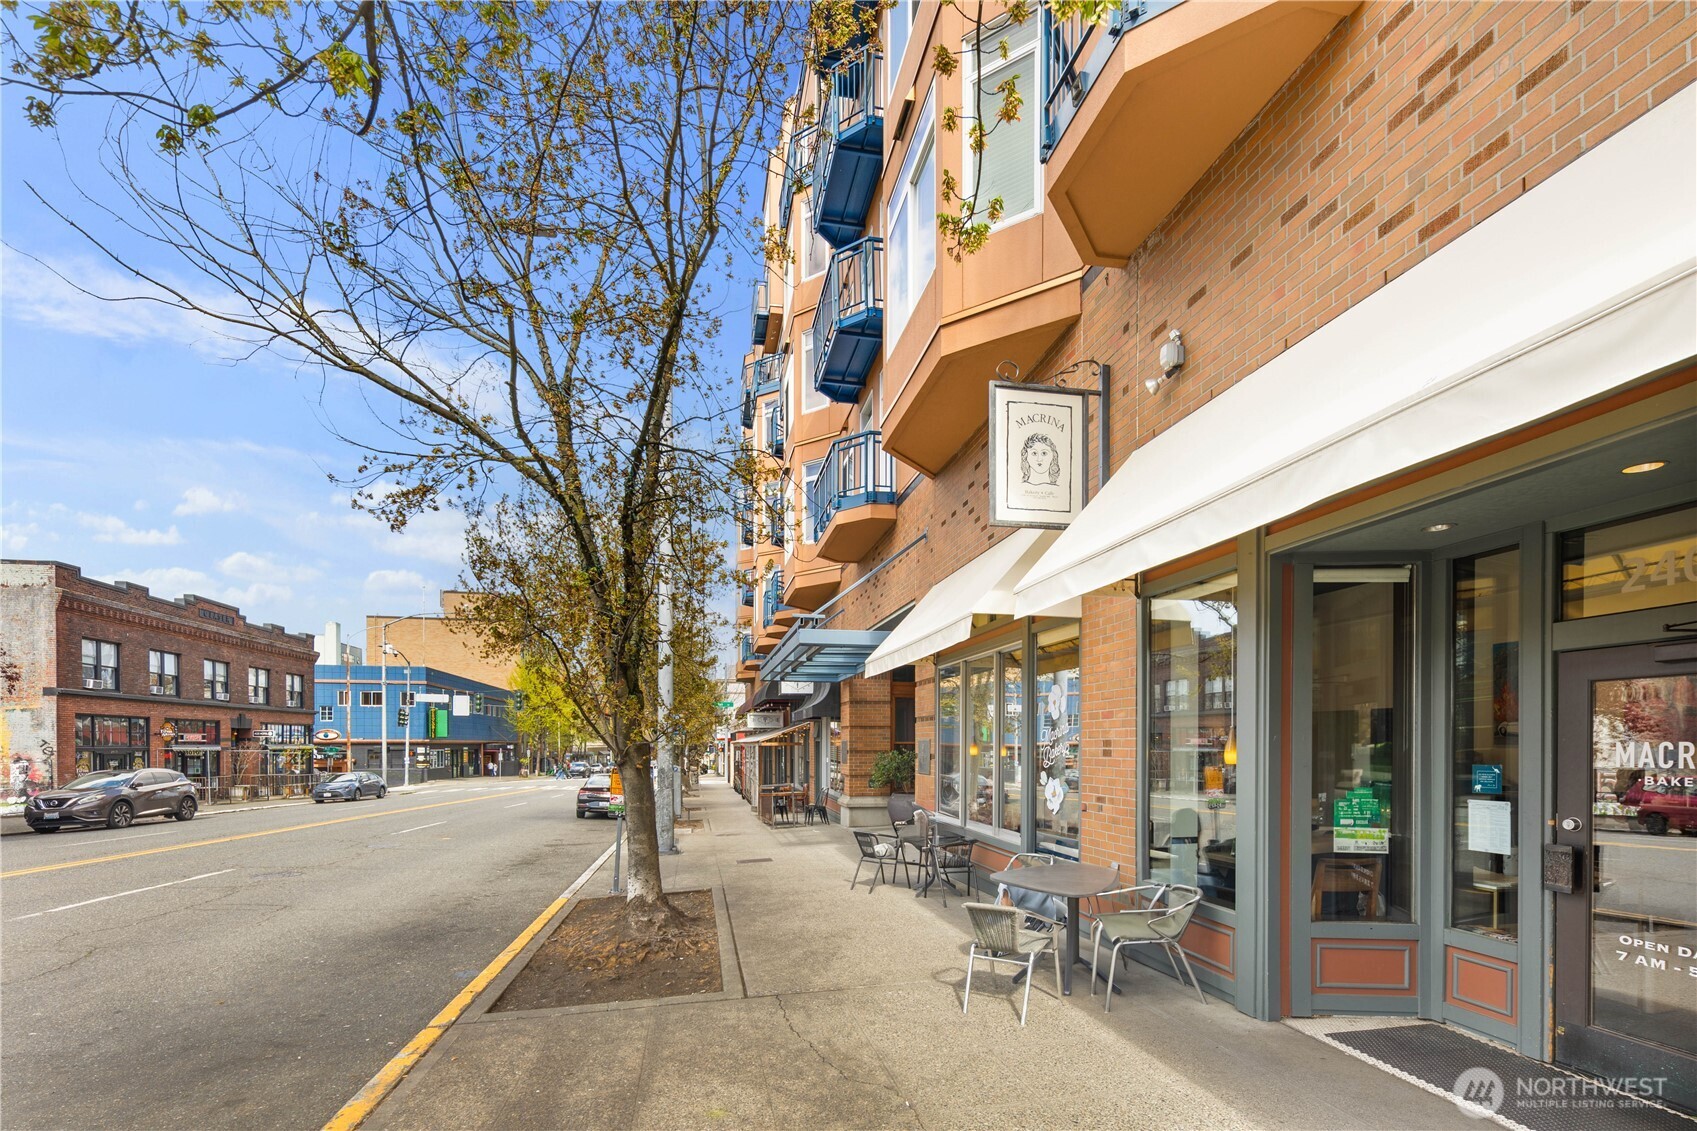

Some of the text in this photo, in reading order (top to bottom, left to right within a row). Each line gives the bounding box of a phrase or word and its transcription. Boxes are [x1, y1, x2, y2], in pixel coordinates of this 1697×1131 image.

[1015, 413, 1066, 433] MACRINA
[1615, 741, 1696, 769] MACR
[1618, 935, 1697, 960] OPEN D
[1615, 949, 1628, 961] 7
[1634, 955, 1666, 971] AM
